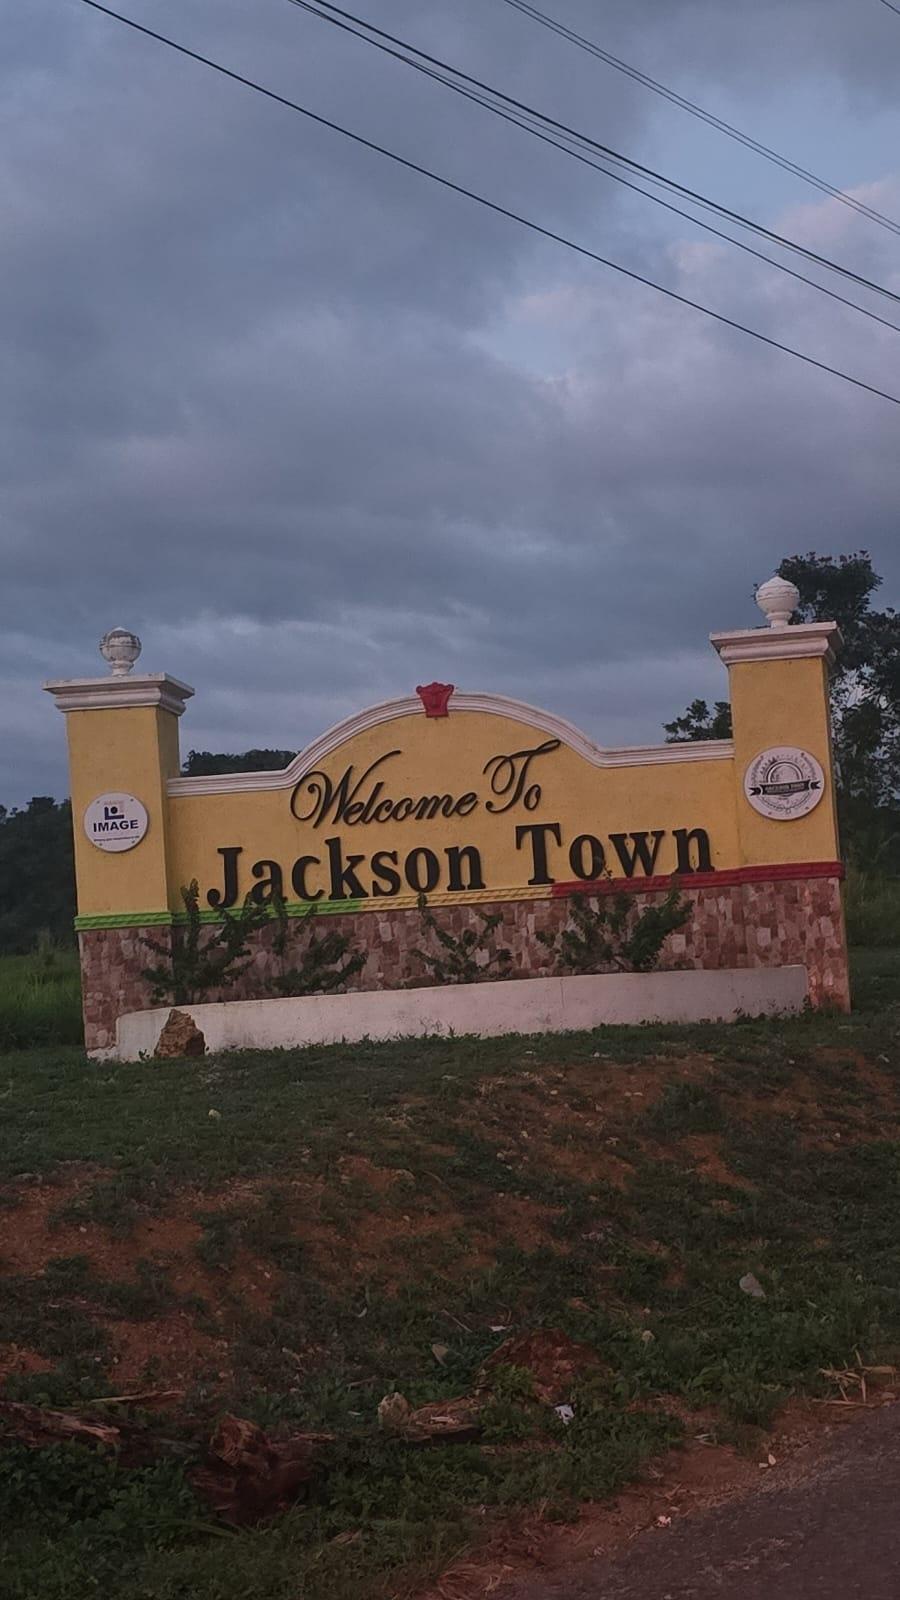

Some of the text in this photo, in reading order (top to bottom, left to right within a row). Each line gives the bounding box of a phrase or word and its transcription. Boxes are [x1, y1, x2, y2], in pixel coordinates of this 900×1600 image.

[93, 819, 139, 833] IMAGE
[290, 739, 561, 829] Welcome To
[206, 823, 715, 908] Jackson Town
